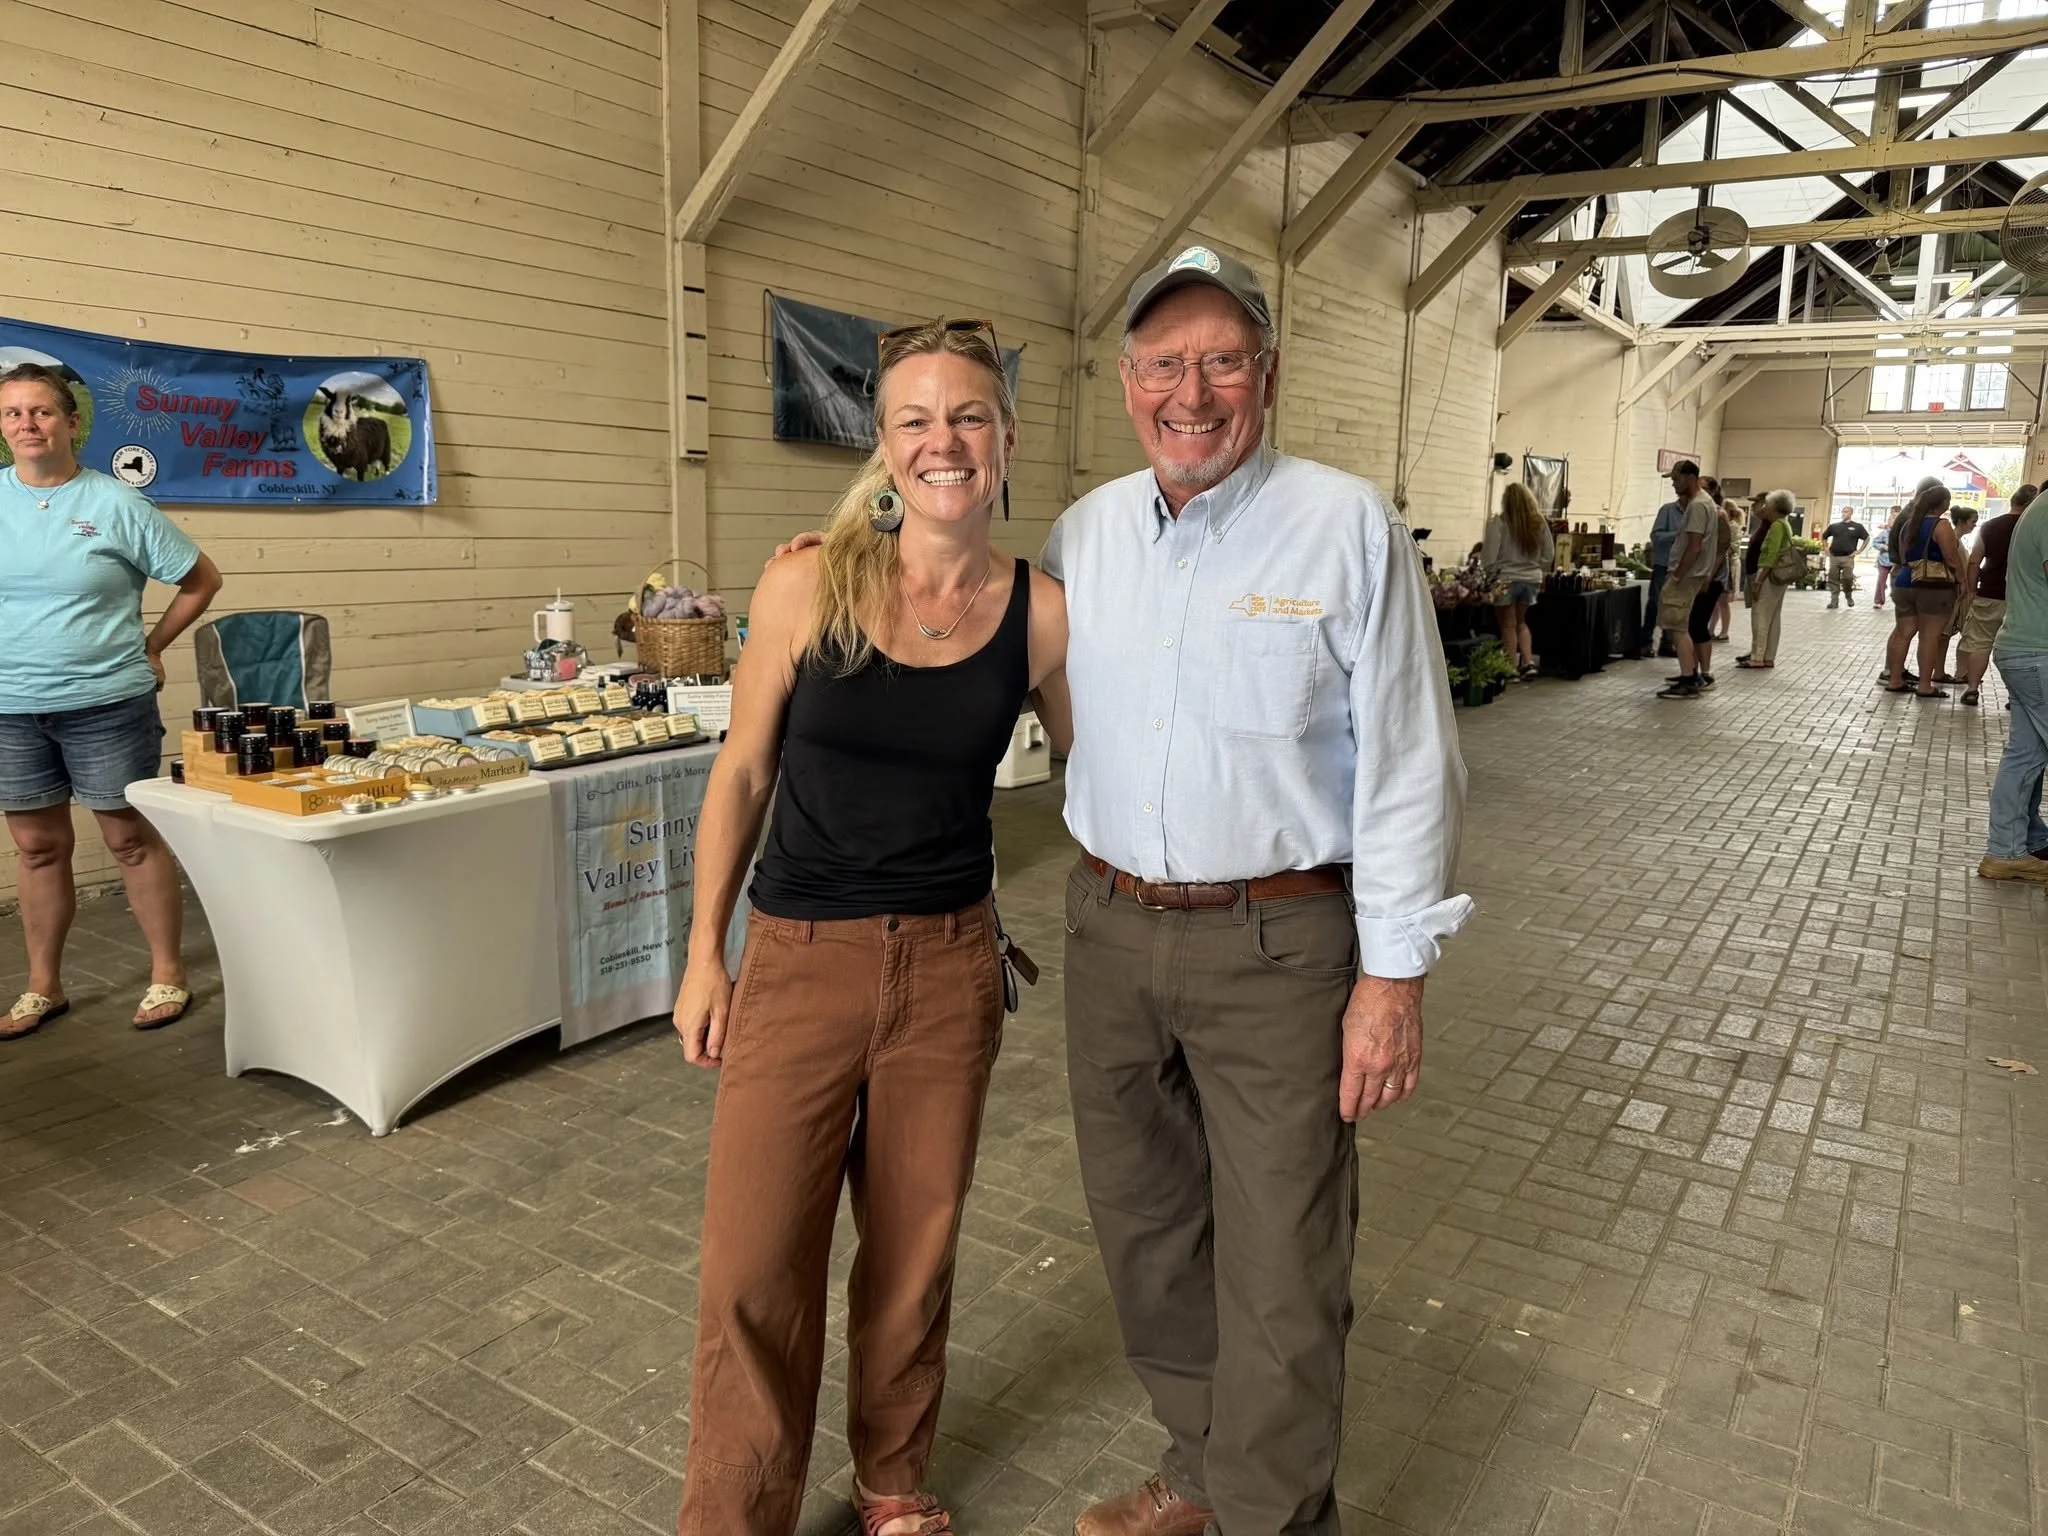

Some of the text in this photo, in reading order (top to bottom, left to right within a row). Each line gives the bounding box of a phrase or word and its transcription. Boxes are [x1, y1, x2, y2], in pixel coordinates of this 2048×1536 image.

[136, 385, 238, 421] Sunny
[181, 421, 268, 454] Valley
[141, 450, 154, 463] STATE
[203, 452, 296, 478] Farms
[258, 483, 339, 495] Cobleskill, NY
[1273, 597, 1320, 607] Agriculture
[1290, 607, 1323, 615] Markets
[480, 765, 516, 779] Market
[616, 767, 705, 792] Gifts, Decor & More
[629, 814, 698, 846] Sunny
[584, 858, 661, 893] Valley
[603, 898, 627, 911] Home
[629, 892, 640, 903] of
[639, 887, 669, 900] Sunny
[600, 946, 642, 965] Cobleskill,
[642, 941, 662, 952] New
